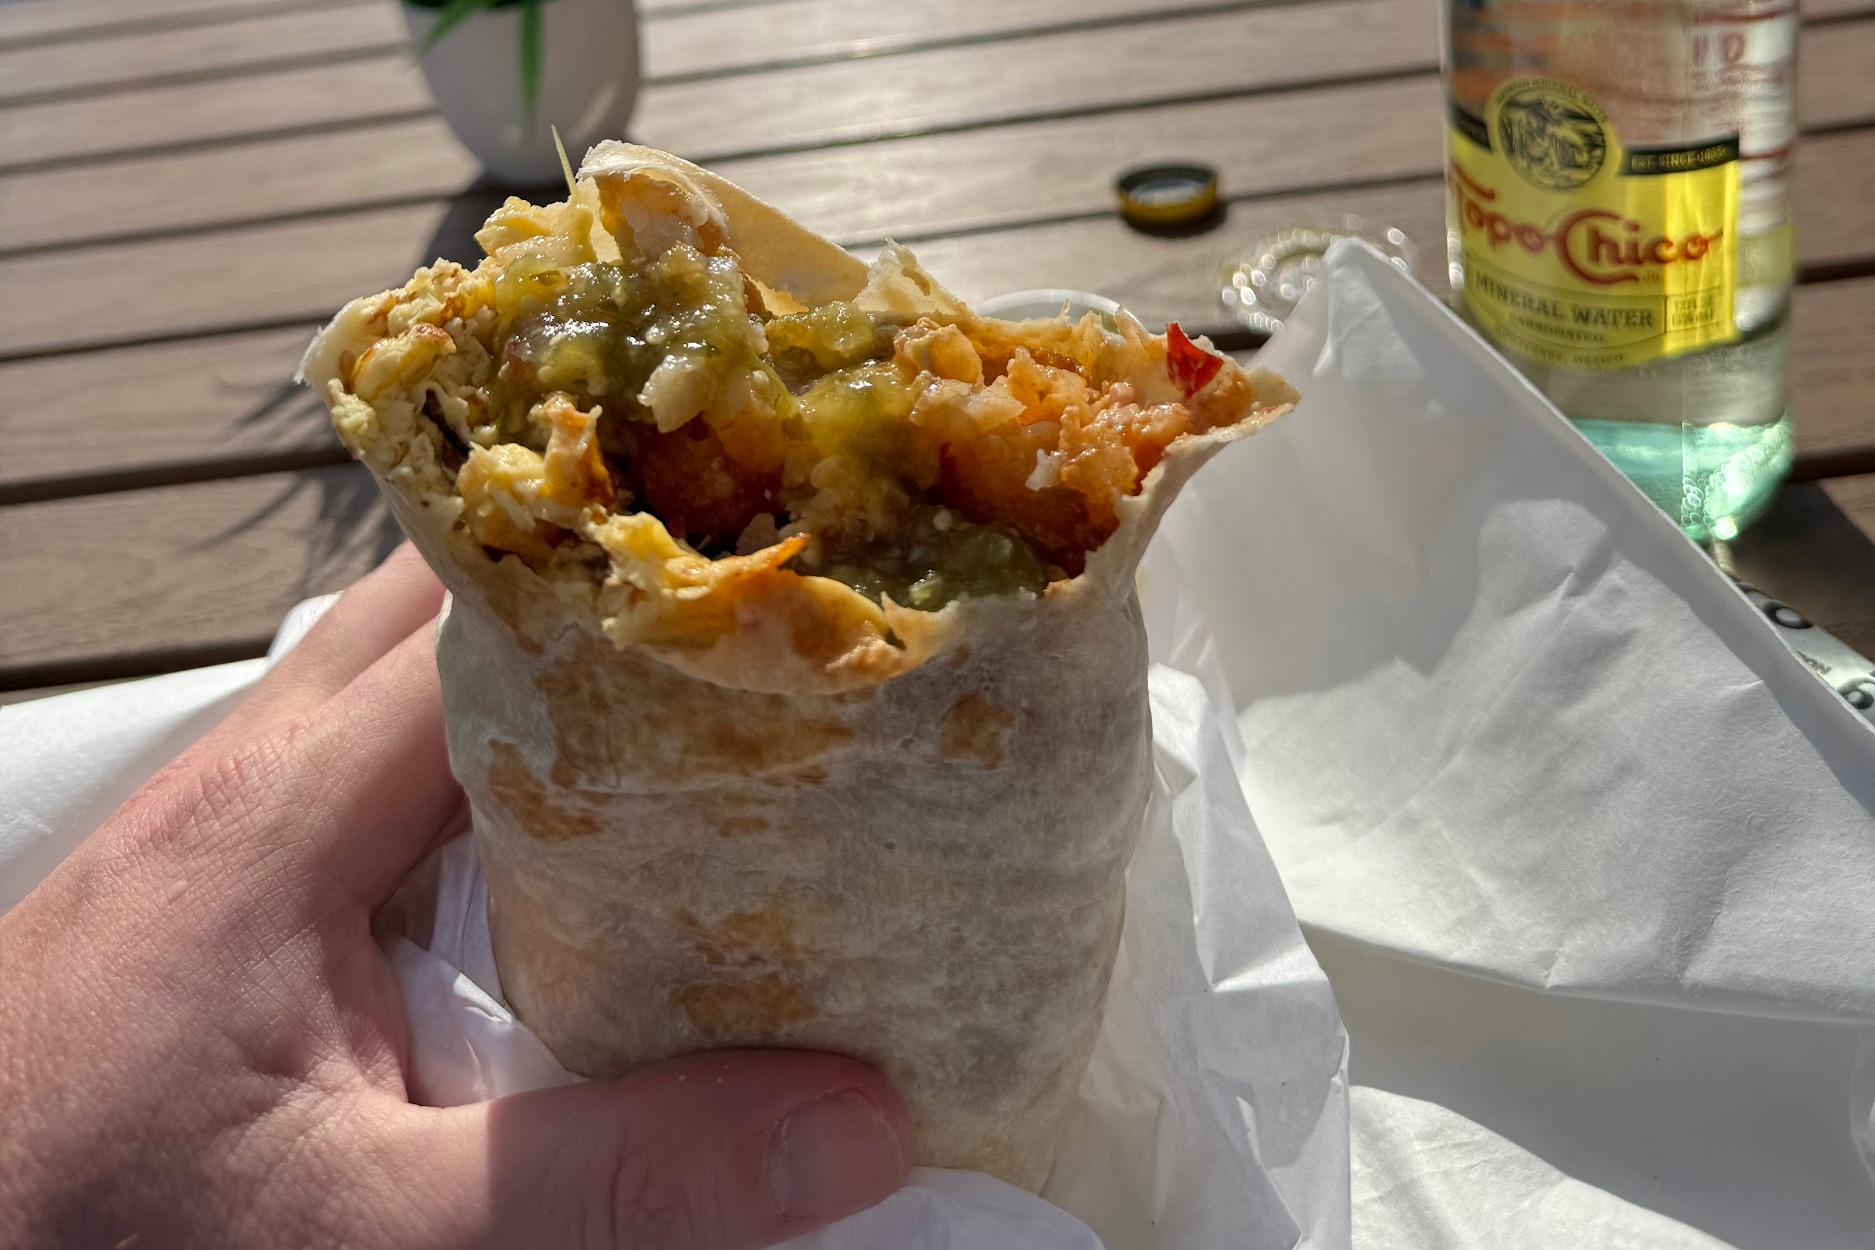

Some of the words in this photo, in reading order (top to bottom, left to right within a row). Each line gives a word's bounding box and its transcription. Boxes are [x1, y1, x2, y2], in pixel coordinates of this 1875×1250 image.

[1555, 207, 1724, 285] Chico
[1475, 270, 1564, 320] MINERAL
[1569, 302, 1653, 327] WATER
